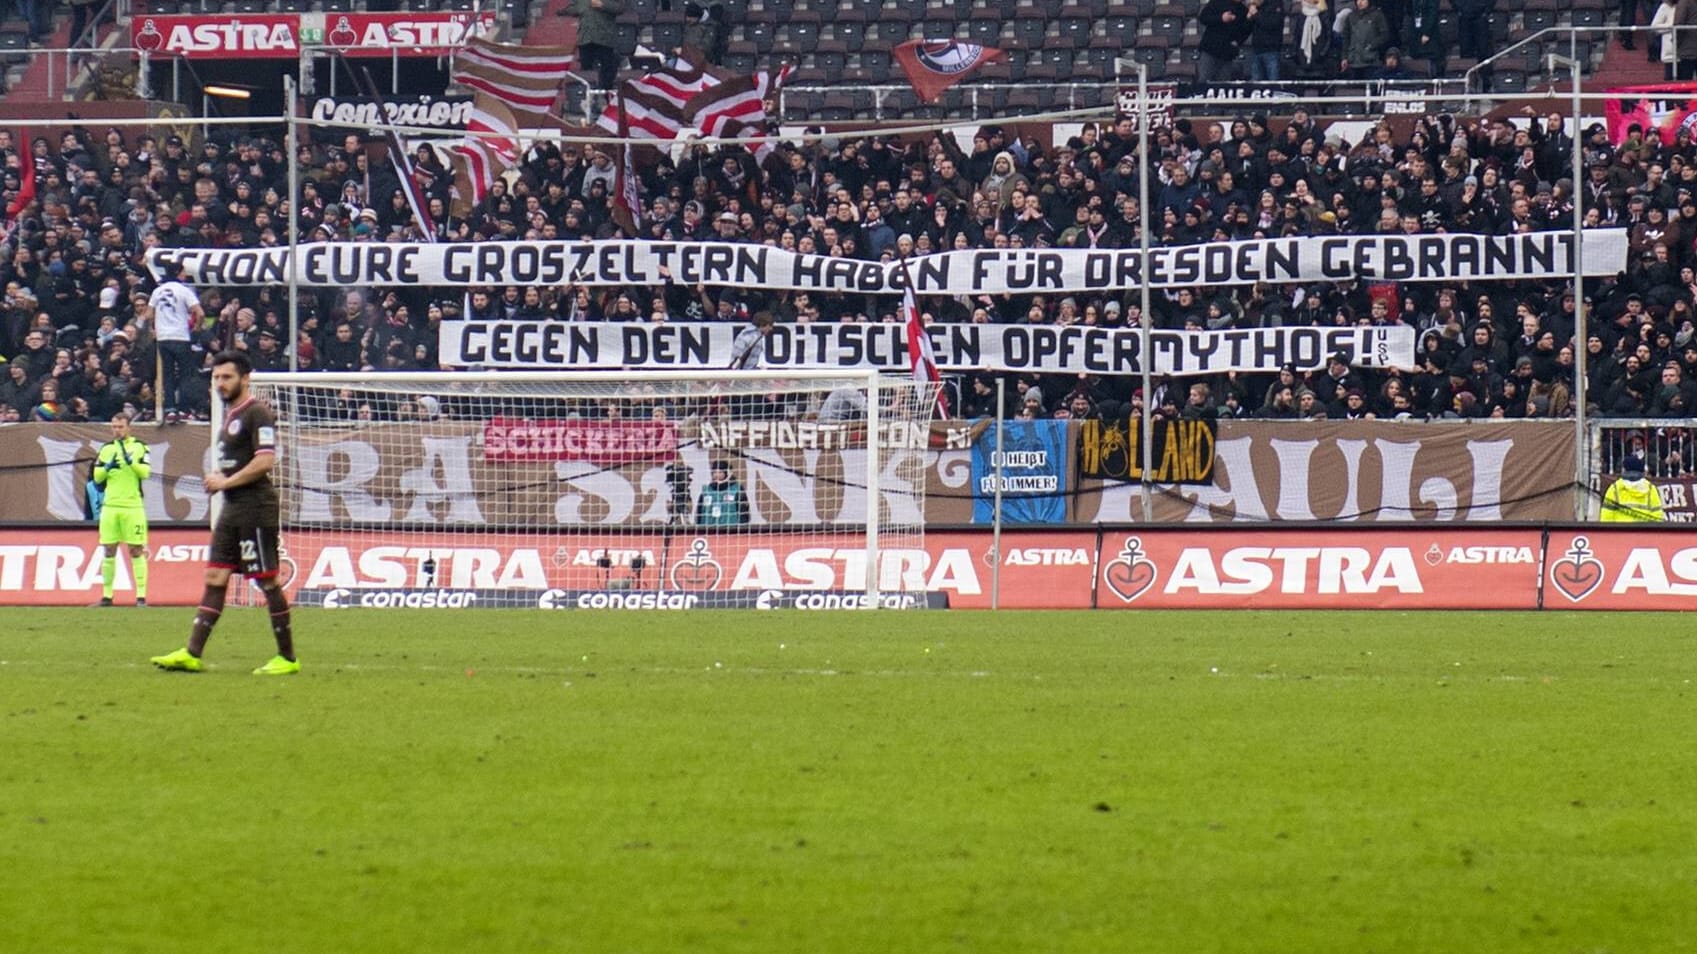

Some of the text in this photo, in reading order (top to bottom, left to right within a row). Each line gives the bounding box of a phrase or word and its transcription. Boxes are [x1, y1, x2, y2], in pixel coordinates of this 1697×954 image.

[166, 23, 296, 51] ASTRA
[305, 246, 419, 283] EURE
[444, 244, 768, 284] GROSZELTERN
[972, 252, 1064, 290] FÜR
[1085, 241, 1299, 288] DRESDEN
[1321, 235, 1579, 279] GEBRANNT
[460, 324, 599, 364] GEGEN
[622, 325, 710, 365] DEN
[733, 324, 980, 367] OiTSCHEN
[485, 426, 678, 455] SCHICKERIA
[304, 546, 548, 589] ASTRA
[730, 548, 982, 595] ASTRA
[1005, 548, 1089, 565] ASTRA
[1163, 546, 1424, 594] ASTRA
[1446, 546, 1535, 563] ASTRA
